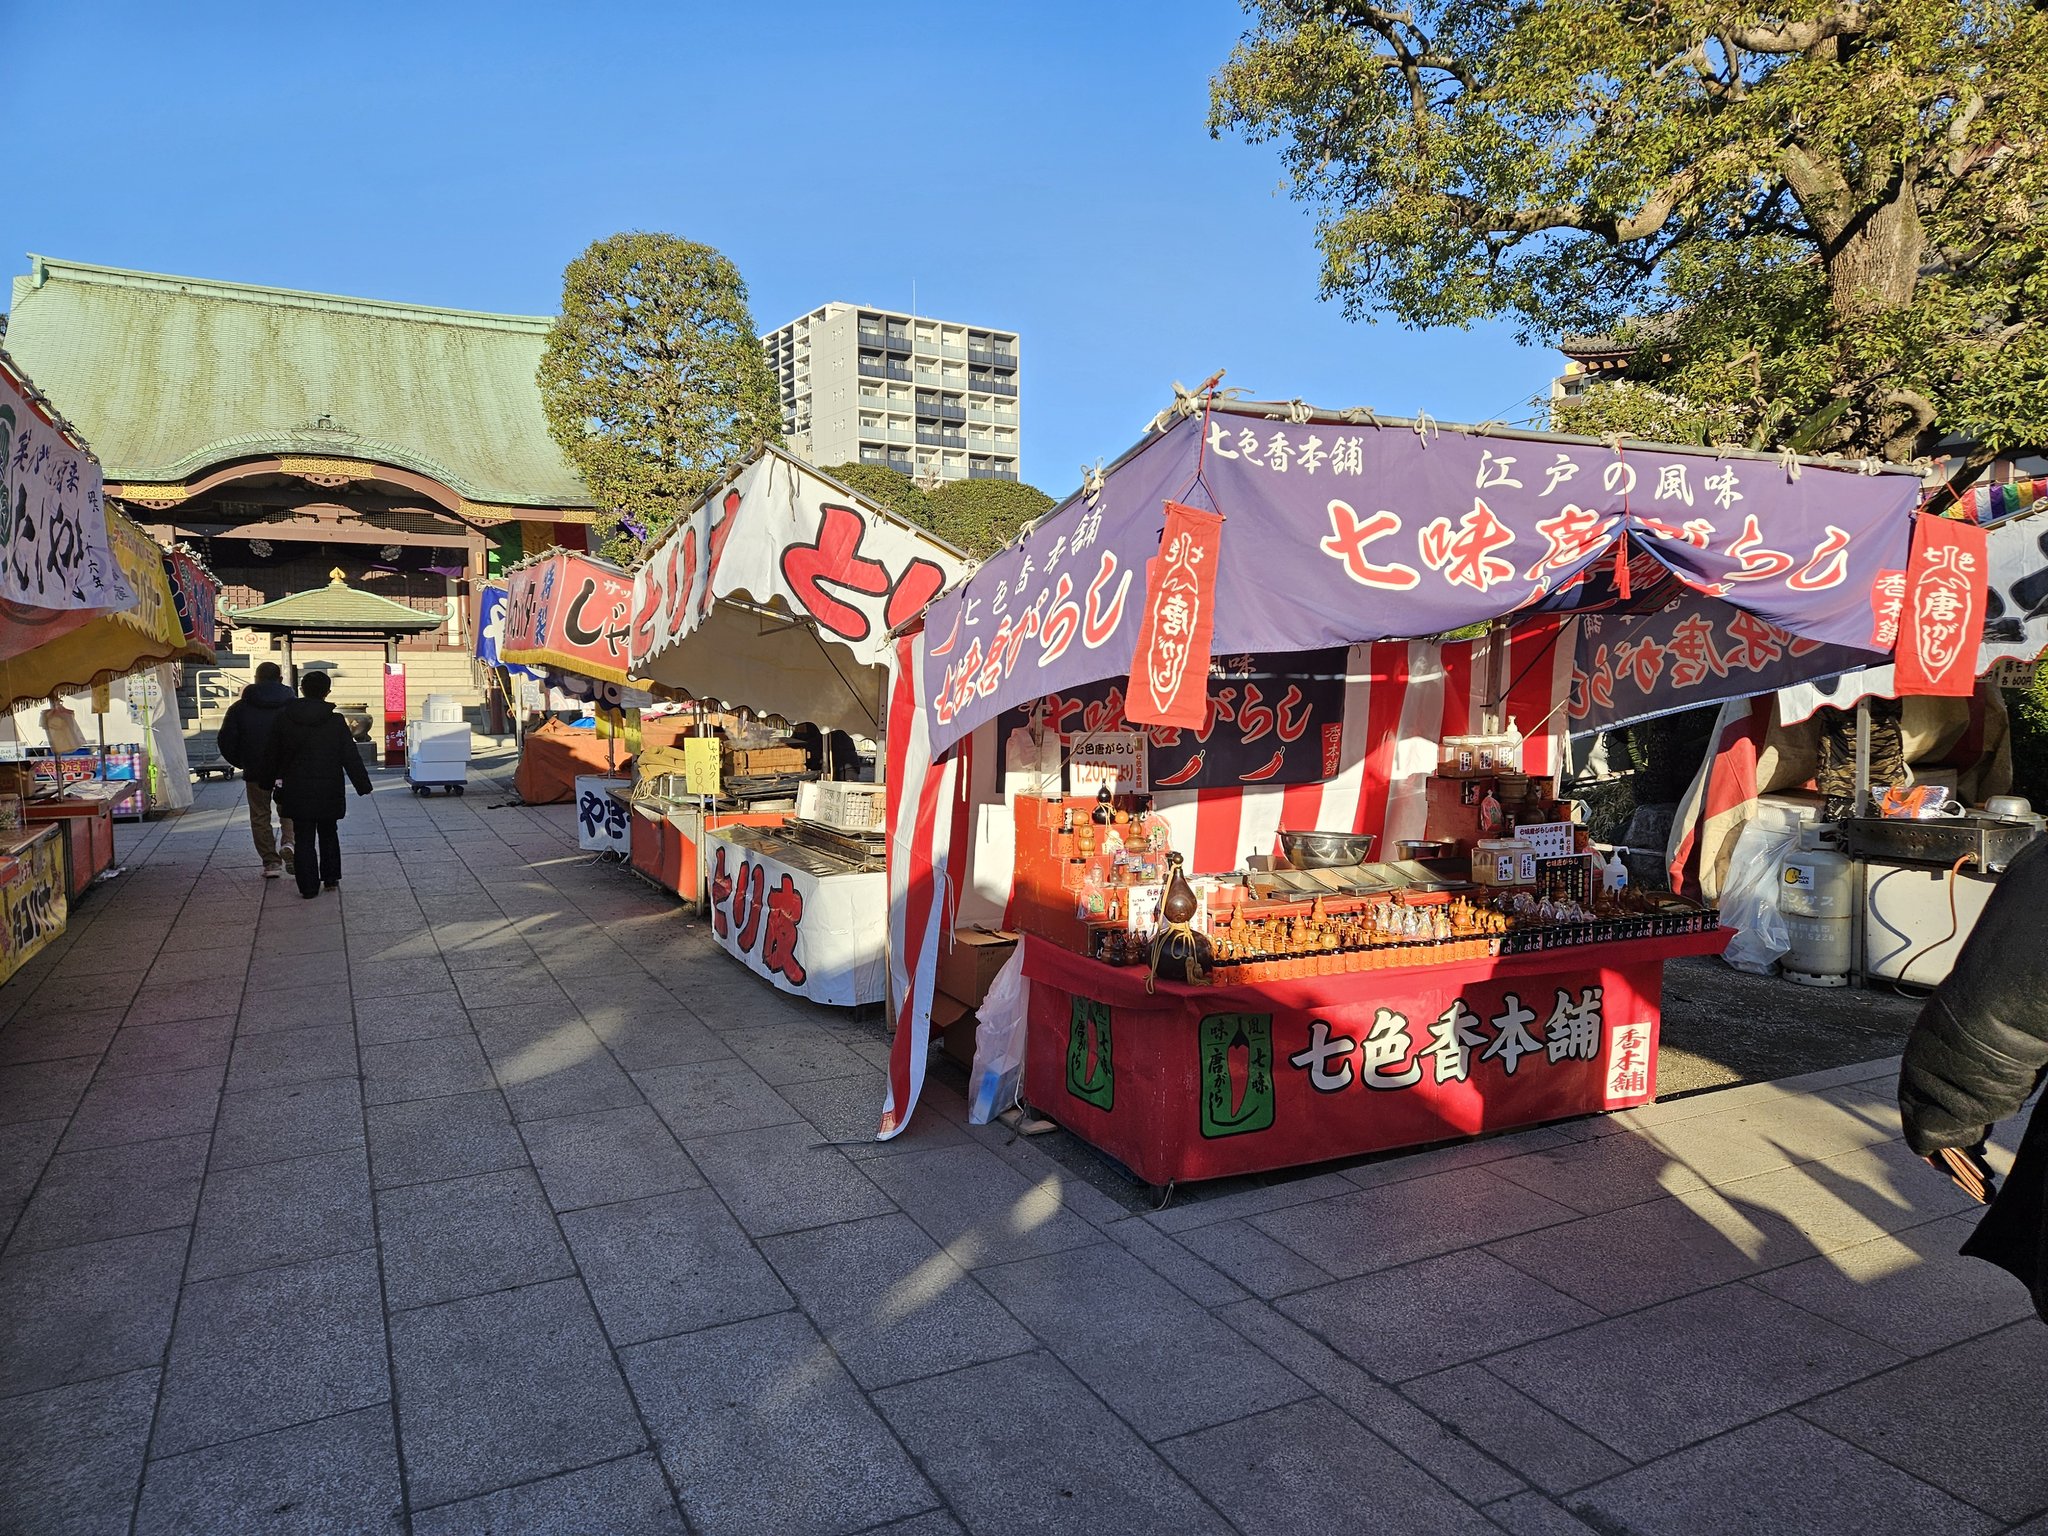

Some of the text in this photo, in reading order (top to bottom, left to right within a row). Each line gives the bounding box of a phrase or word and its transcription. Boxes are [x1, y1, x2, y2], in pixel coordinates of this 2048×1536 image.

[1205, 421, 1363, 476] 七色香本舗
[1476, 450, 1744, 510] 江戸の風味
[965, 503, 1107, 627] 七色香本舗
[1922, 546, 1976, 573] 七色
[933, 549, 1133, 726] 七味唐がらし
[1920, 586, 1964, 668] 唐がらし
[2012, 677, 2032, 686] 600円
[1035, 683, 1313, 748] 七味がらし
[1075, 743, 1134, 755] 七色唐がらし
[1075, 761, 1134, 784] 1,200円より
[711, 845, 807, 987] とり皮
[1289, 986, 1604, 1093] 七色香本舗
[1612, 1028, 1647, 1093] 香本舗
